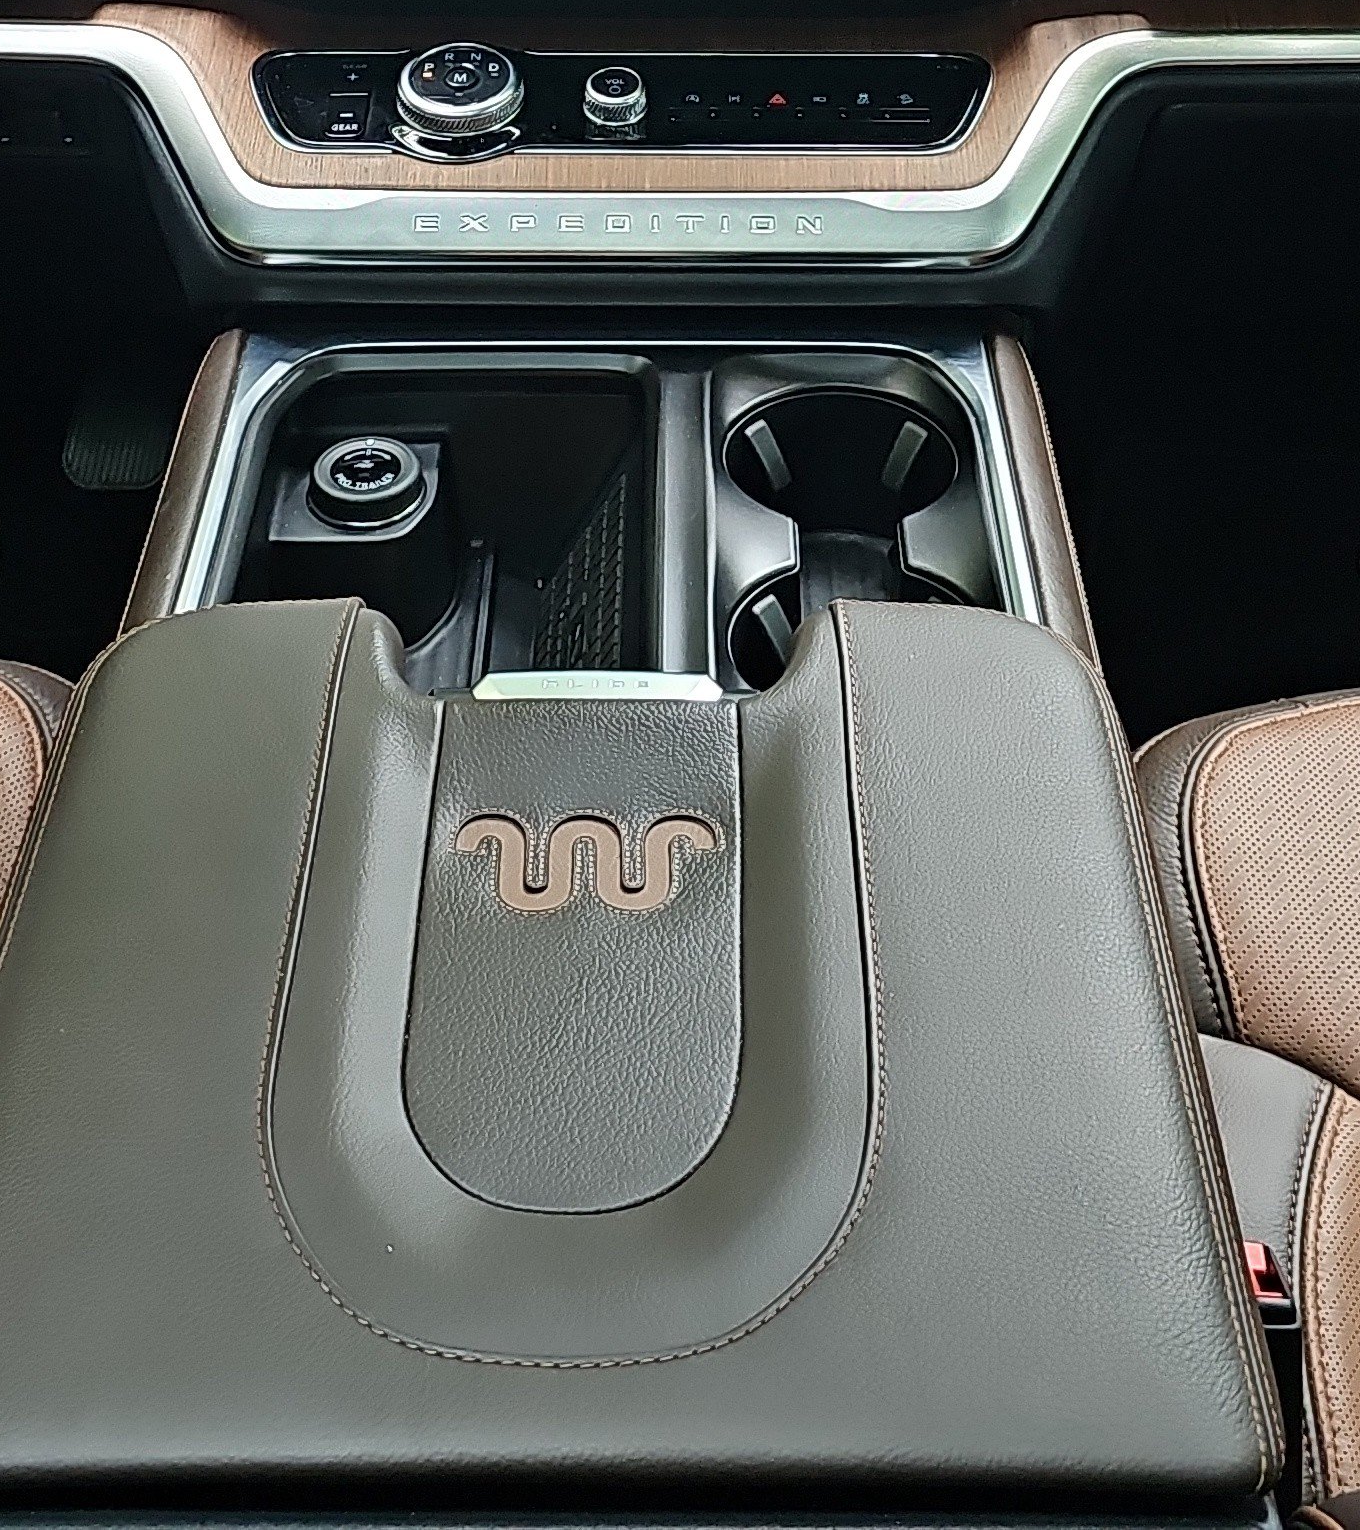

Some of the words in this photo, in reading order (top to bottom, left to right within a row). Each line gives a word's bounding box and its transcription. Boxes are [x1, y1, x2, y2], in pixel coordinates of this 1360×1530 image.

[445, 52, 454, 61] R
[470, 52, 481, 61] N
[424, 63, 434, 72] P
[488, 63, 499, 72] D
[453, 72, 468, 83] M
[331, 123, 358, 131] GEAR
[412, 212, 824, 235] EXPEDITION
